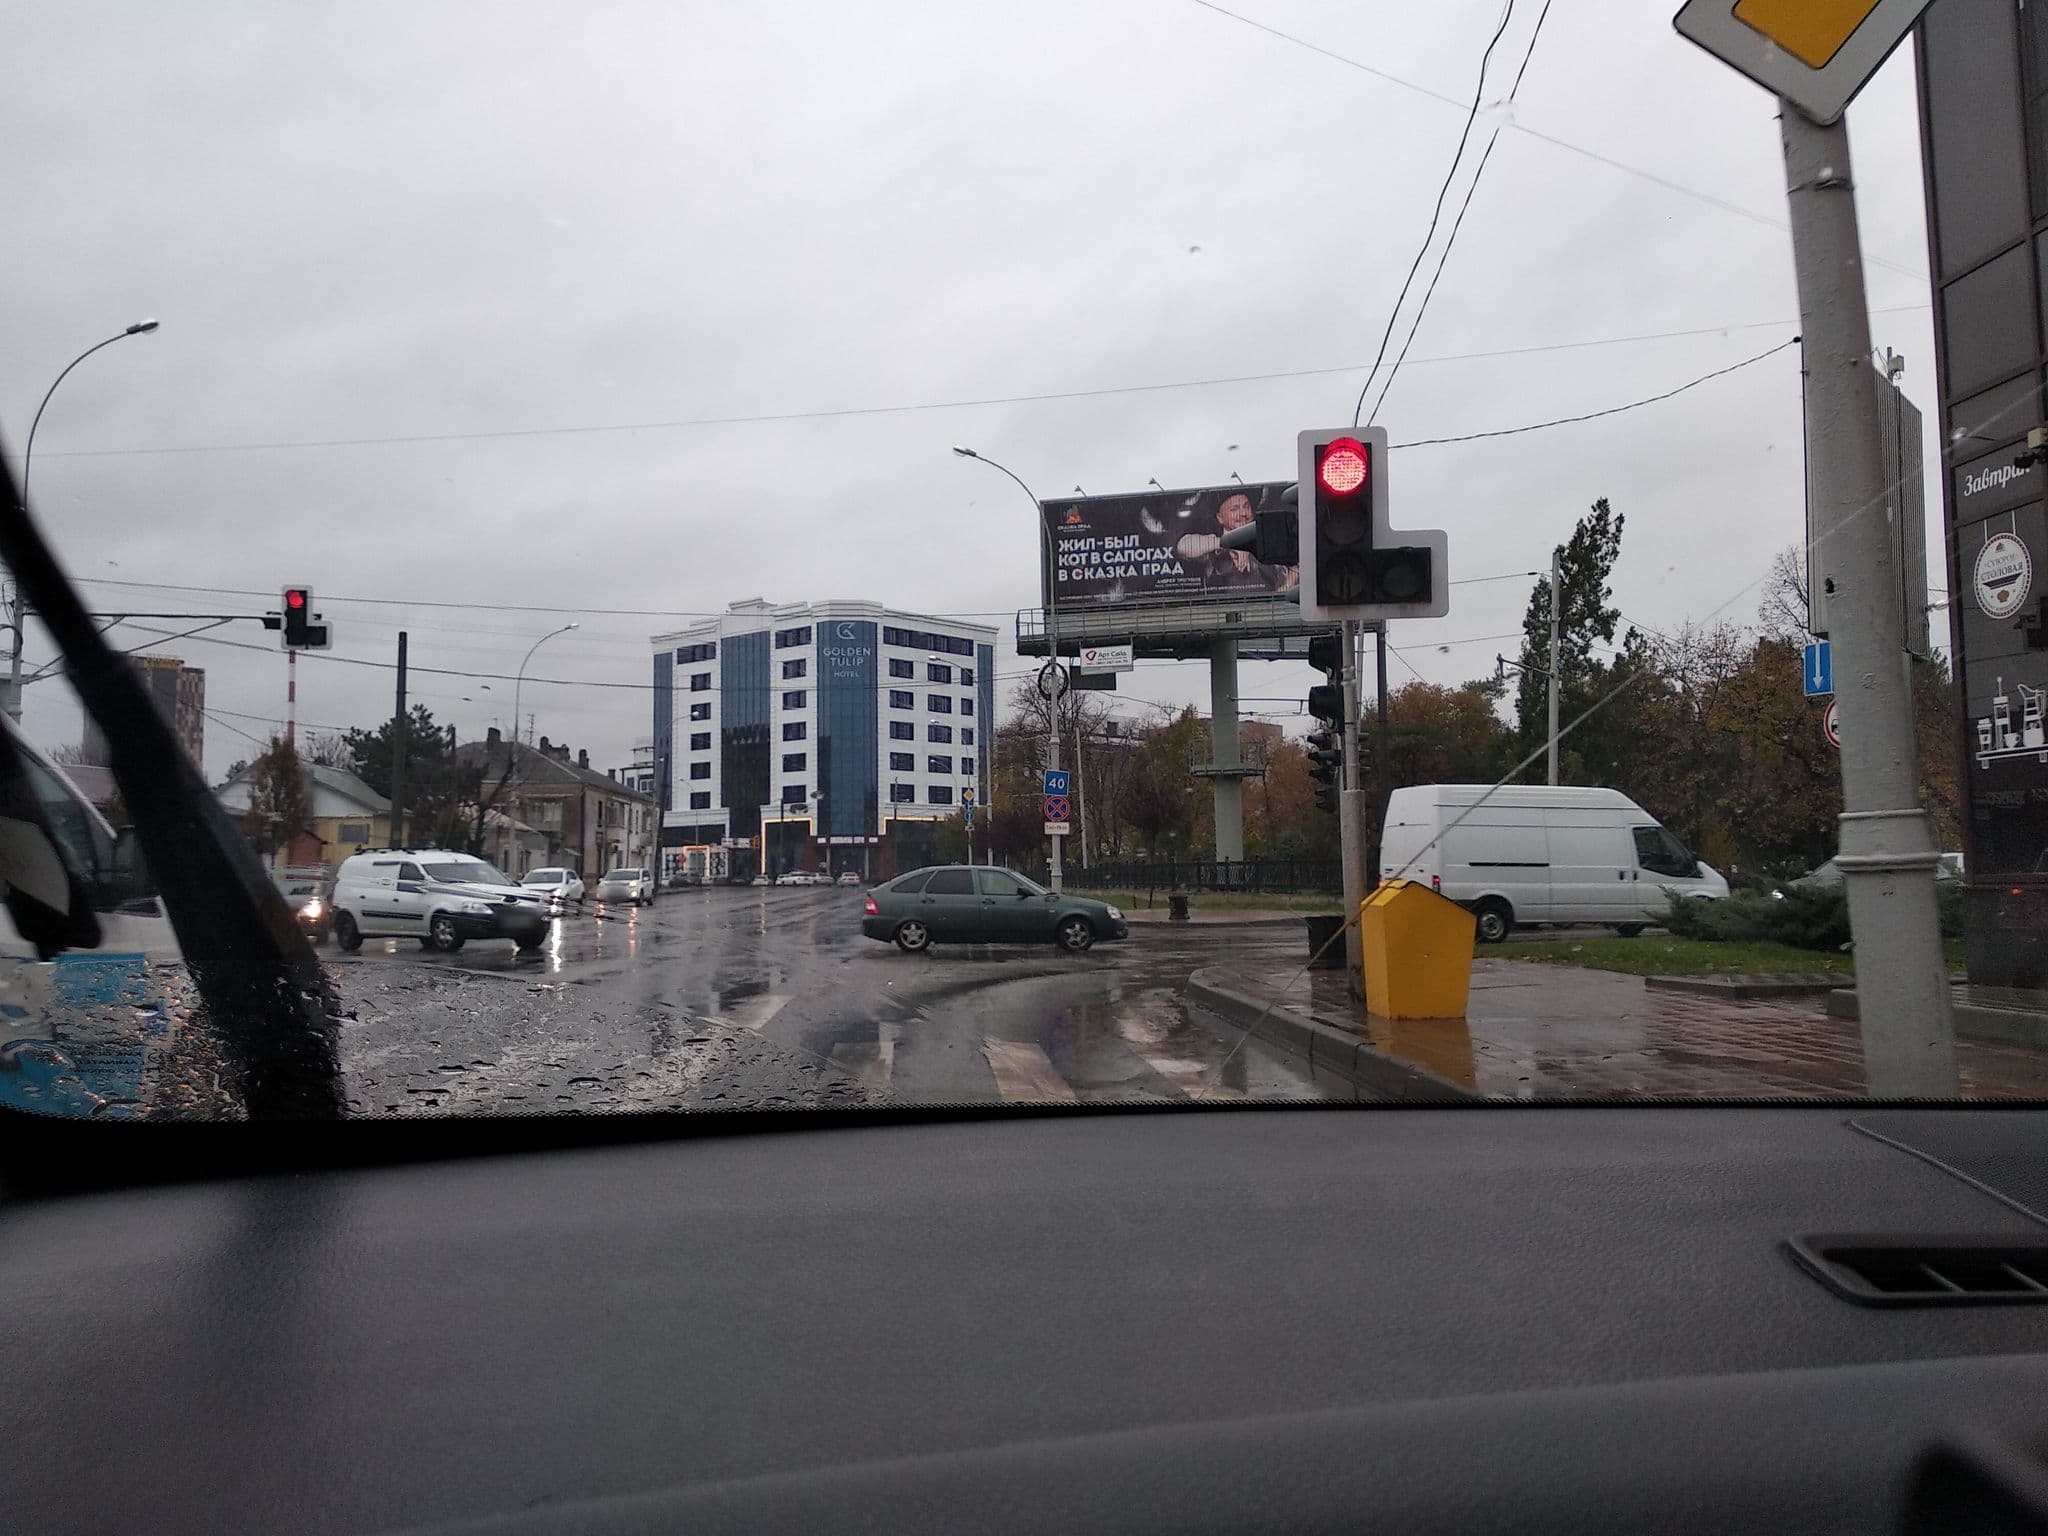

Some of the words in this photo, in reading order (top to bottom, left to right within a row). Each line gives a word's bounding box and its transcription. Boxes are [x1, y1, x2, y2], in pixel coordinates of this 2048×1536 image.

[1059, 534, 1140, 553] ЖИЛ-БЫЛ
[1059, 553, 1088, 567] КОТ
[1091, 552, 1101, 564] В
[1103, 546, 1175, 563] САПОГАХ
[1059, 569, 1069, 581] В
[1071, 564, 1138, 580] СКАЗКА
[1142, 561, 1185, 576] ГРАД
[1981, 561, 2024, 581] СТОЛОВАЯ
[823, 647, 871, 657] GOLDEN
[830, 657, 864, 667] TULIP
[833, 670, 859, 678] HOTEL
[1048, 777, 1065, 790] 40
